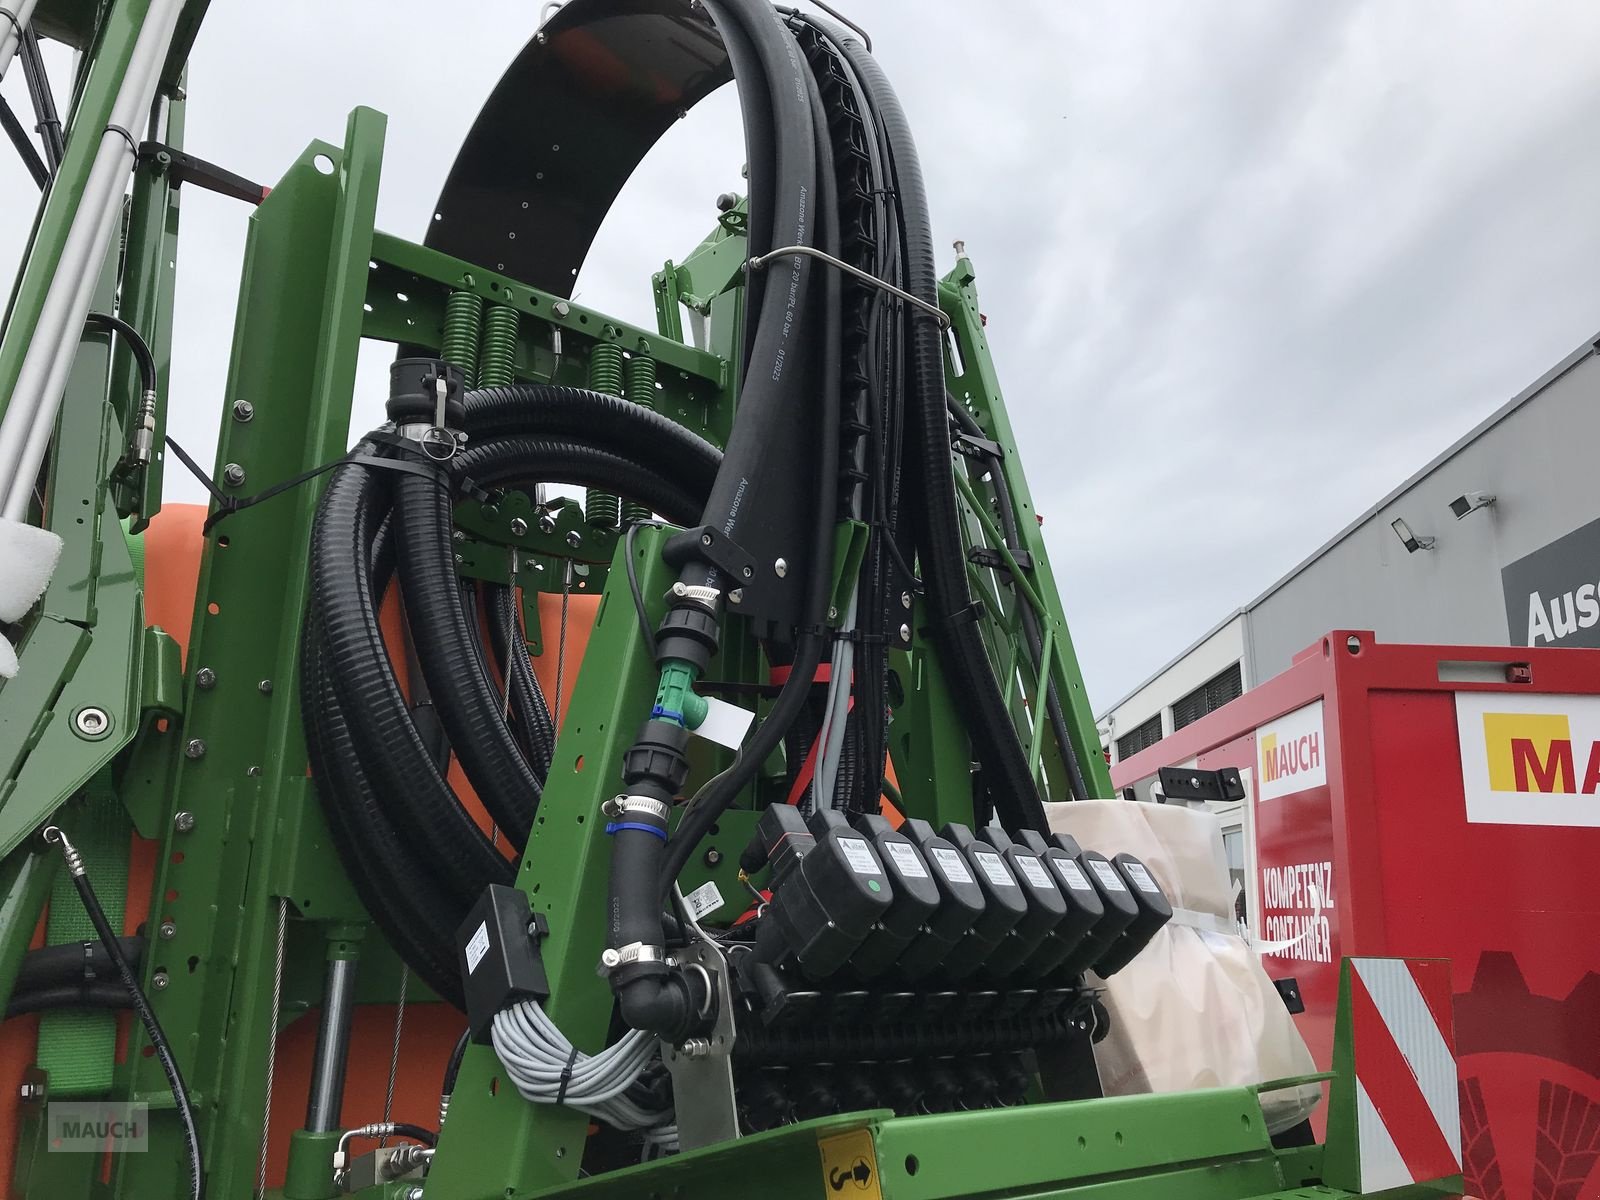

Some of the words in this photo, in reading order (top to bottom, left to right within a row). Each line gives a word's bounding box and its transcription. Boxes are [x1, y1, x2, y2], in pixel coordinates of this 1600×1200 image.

[798, 185, 808, 223] Amazone
[796, 224, 806, 246] Werk
[792, 270, 800, 281] 20
[782, 322, 792, 338] bar
[771, 348, 786, 382] 01/2025
[729, 477, 749, 517] Amazone
[705, 577, 716, 587] ba
[1528, 578, 1600, 648] Aus
[1265, 731, 1320, 781] MAUCH
[1263, 861, 1334, 910] KOMPETENZ
[1266, 915, 1332, 963] CONTAINER
